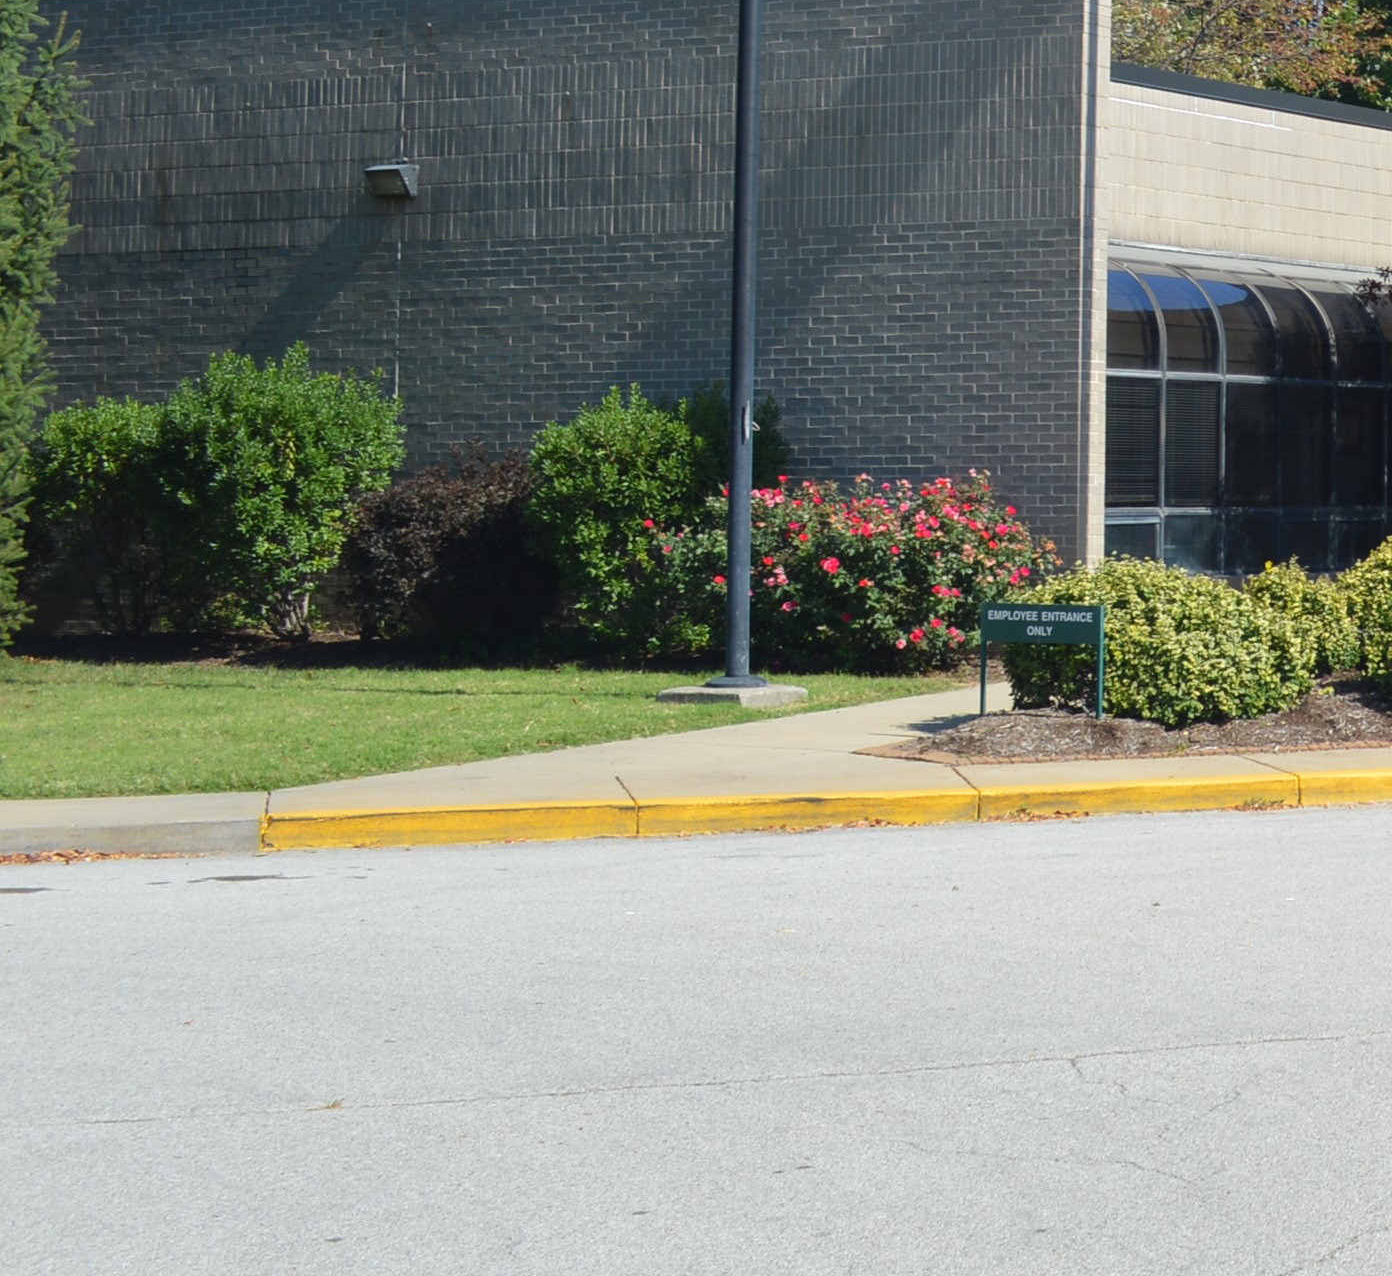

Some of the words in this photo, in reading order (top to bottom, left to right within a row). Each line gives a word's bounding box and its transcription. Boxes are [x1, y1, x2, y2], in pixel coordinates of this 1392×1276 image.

[987, 609, 1038, 621] EMPLOYEE
[1041, 611, 1093, 623] ENTRANCE
[1026, 625, 1053, 637] ONLY
